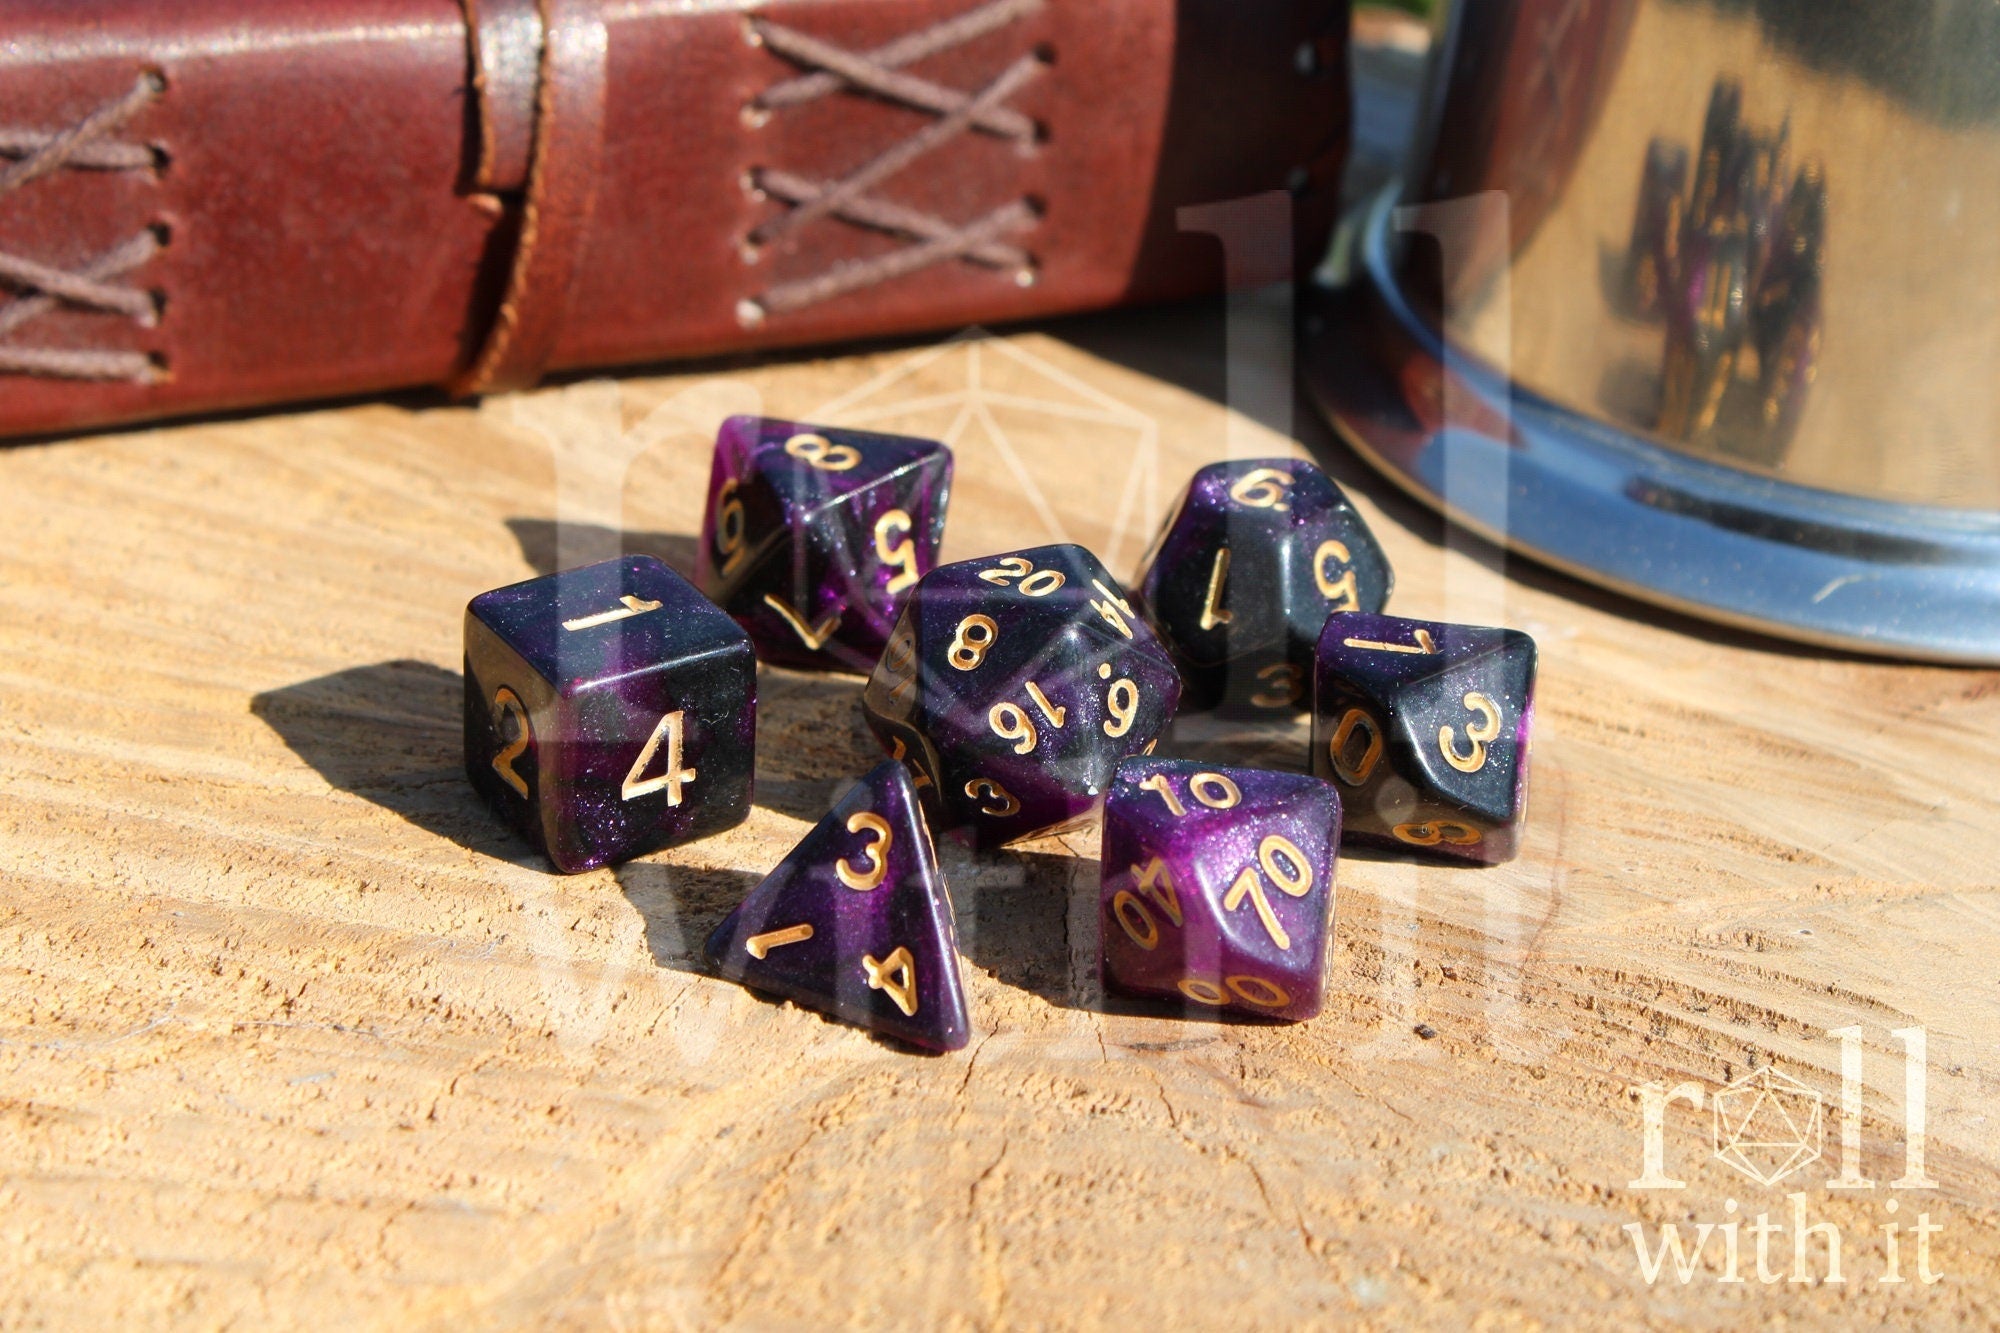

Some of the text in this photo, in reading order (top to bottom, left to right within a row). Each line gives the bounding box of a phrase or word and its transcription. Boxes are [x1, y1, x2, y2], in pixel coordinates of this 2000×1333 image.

[784, 434, 862, 472] 8
[874, 509, 919, 594] 5
[978, 557, 1065, 597] 20
[1313, 540, 1359, 612] 5
[562, 595, 663, 632] 1
[764, 594, 841, 650] 7
[947, 614, 998, 672] 8
[1343, 629, 1440, 655] 1
[492, 687, 529, 799] 2
[621, 711, 696, 806] 4
[1330, 708, 1383, 787] 0
[1439, 692, 1501, 773] 3
[965, 778, 1020, 817] 3
[1139, 773, 1242, 817] 10
[835, 812, 893, 891] 3
[1392, 820, 1482, 846] 8
[1113, 856, 1184, 952] 40
[1223, 835, 1313, 951] 70
[746, 923, 814, 960] 1
[862, 946, 918, 1018] 4
